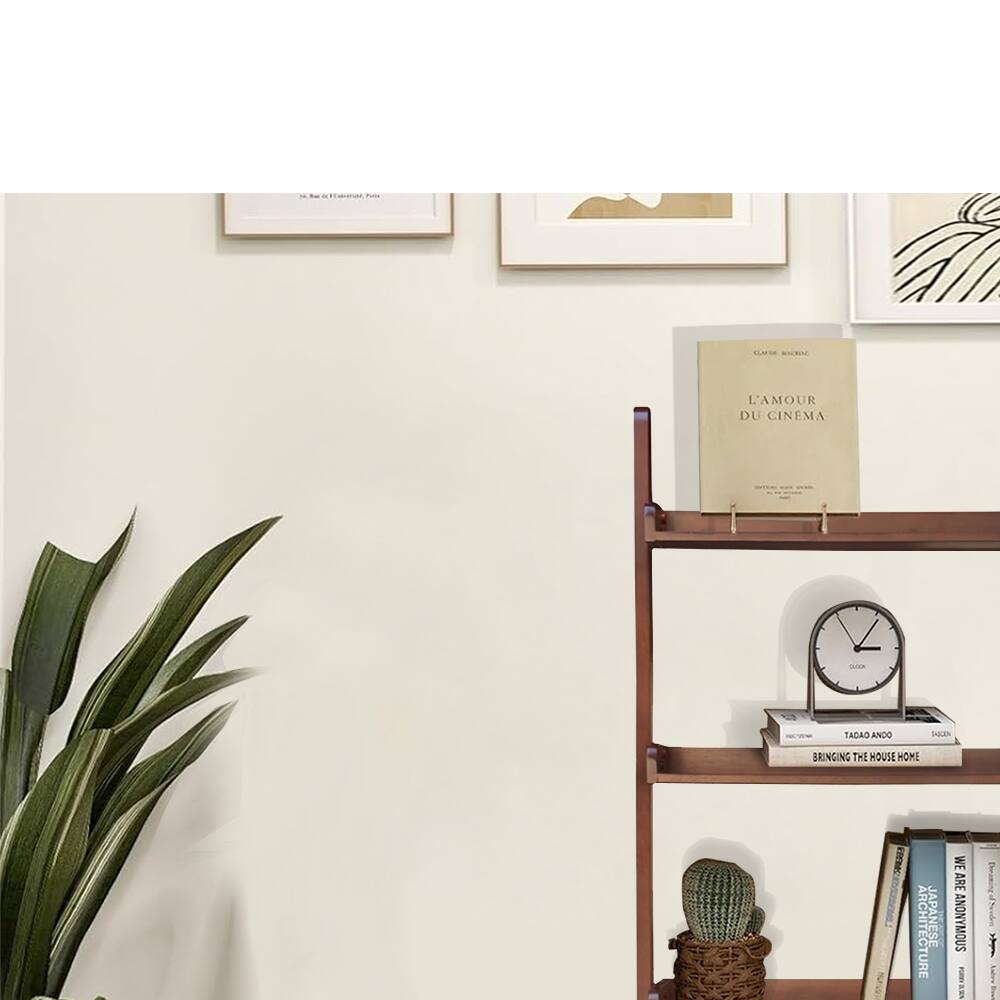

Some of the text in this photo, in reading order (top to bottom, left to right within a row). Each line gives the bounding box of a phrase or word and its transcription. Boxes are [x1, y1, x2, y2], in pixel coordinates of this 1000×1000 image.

[748, 395, 816, 405] L'AMOUR
[740, 410, 760, 421] DU
[844, 731, 893, 740] TADAO ANDO
[812, 752, 920, 762] BRINGING THE HOUSE HOME
[954, 856, 966, 952] WE ARE ANONYMOUS
[927, 886, 938, 948] JAPANESE
[918, 885, 928, 979] ARCHITECTURE
